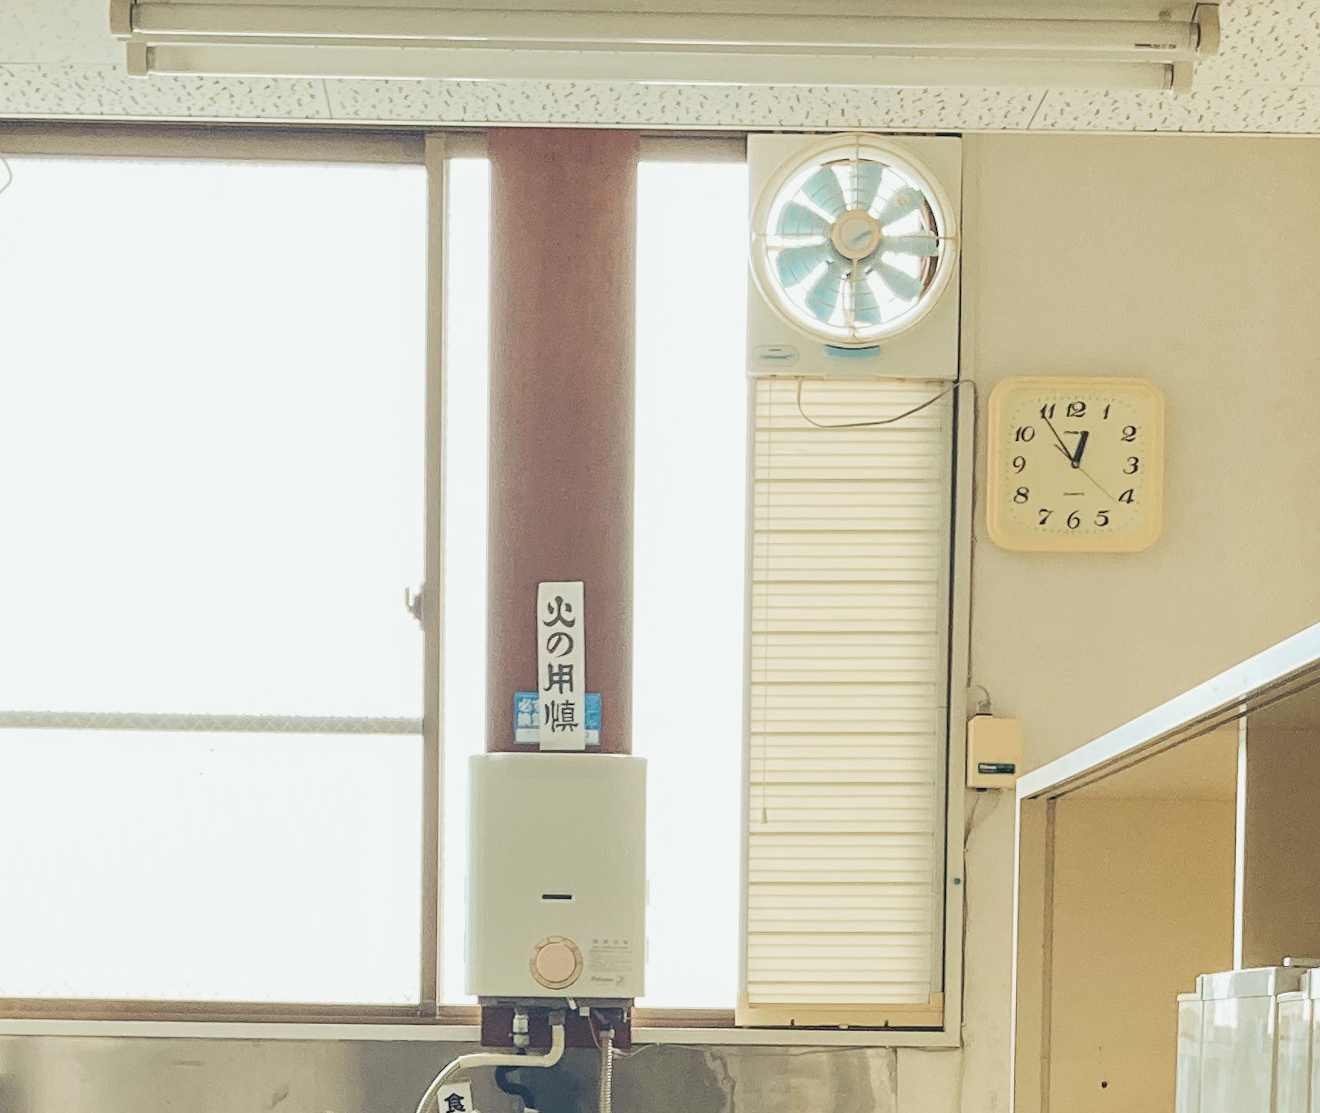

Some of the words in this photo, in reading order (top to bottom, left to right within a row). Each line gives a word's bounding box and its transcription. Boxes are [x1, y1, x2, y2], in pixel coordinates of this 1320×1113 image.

[1039, 403, 1056, 419] 11
[1066, 401, 1086, 418] 12
[1103, 403, 1111, 420] 1
[1014, 425, 1035, 442] 10
[1121, 425, 1137, 442] 2
[1012, 455, 1026, 475] 9
[1122, 456, 1139, 475] 3
[1013, 486, 1030, 504] 8
[1118, 488, 1134, 504] 4
[1038, 508, 1054, 525] 7
[1066, 509, 1081, 530] 6
[1093, 509, 1111, 527] 5
[542, 595, 579, 733] 火の用慎
